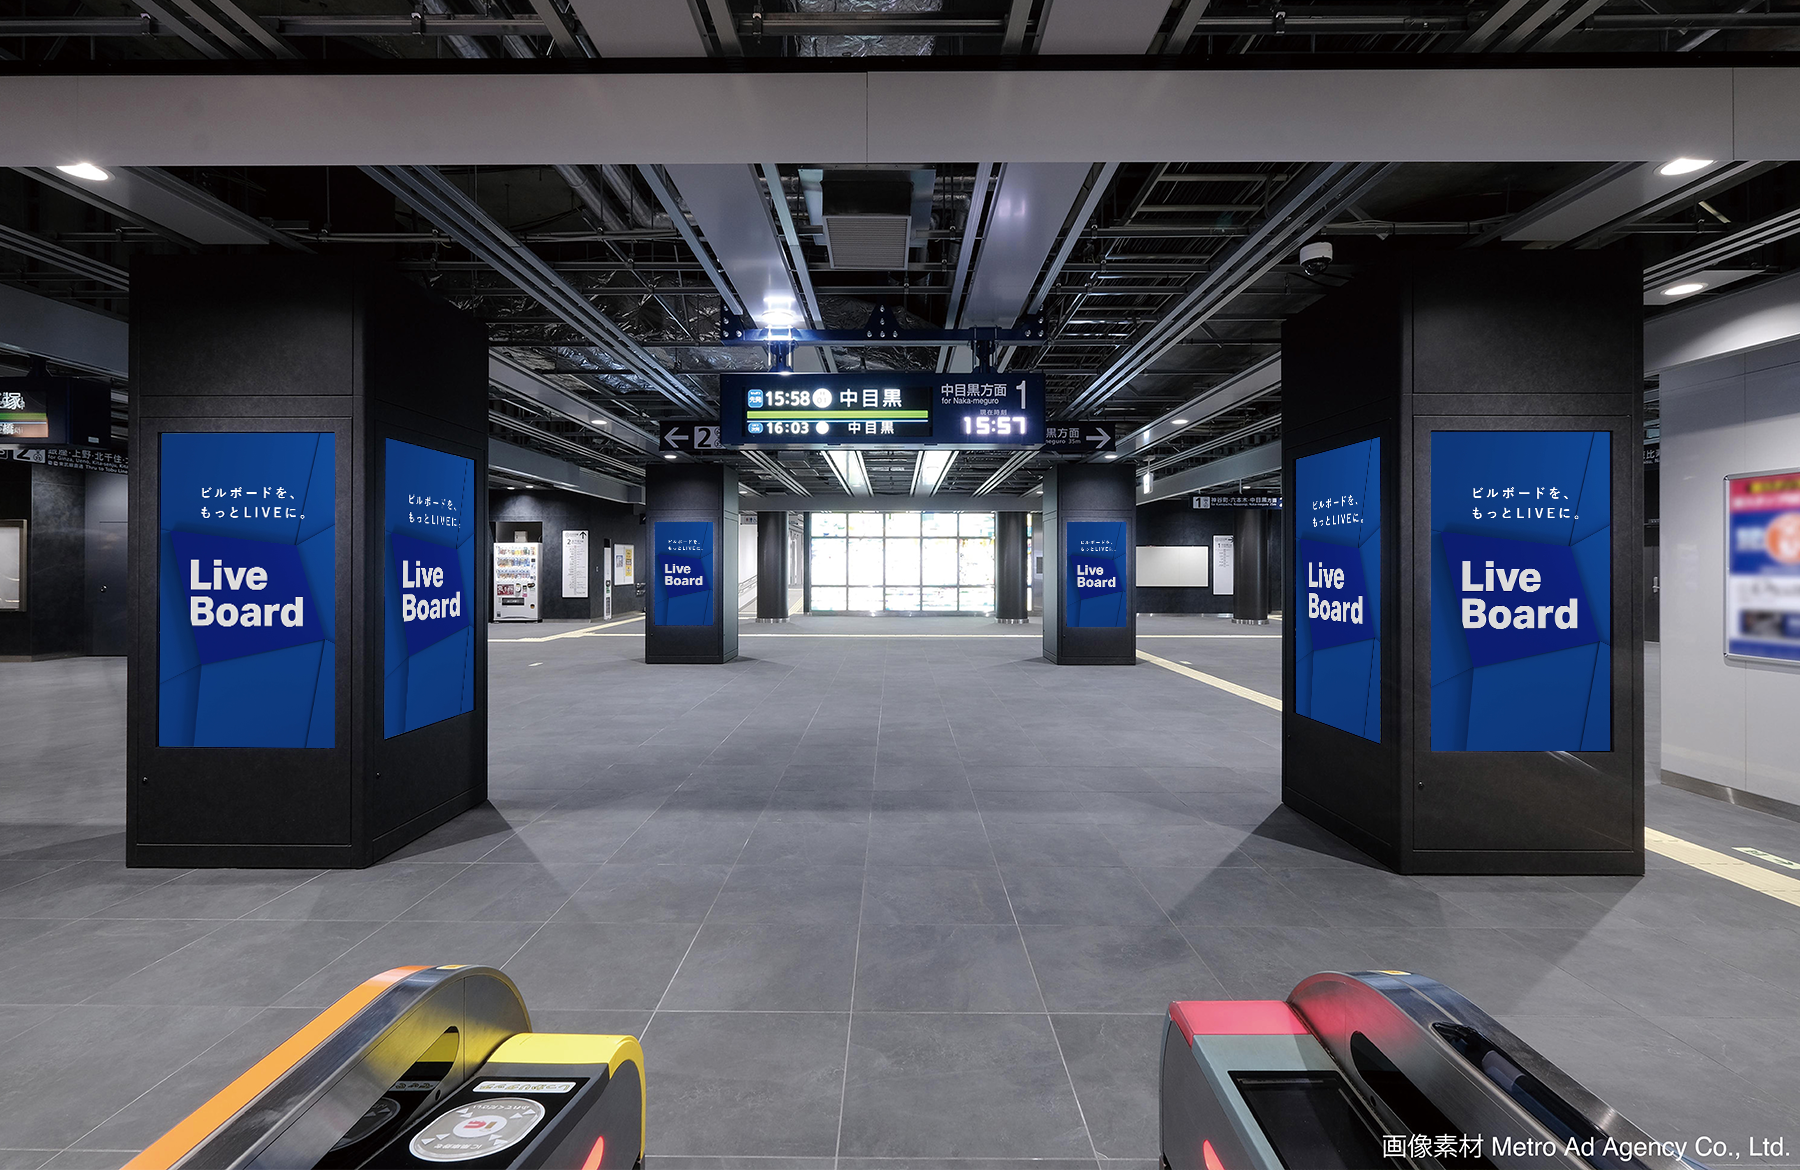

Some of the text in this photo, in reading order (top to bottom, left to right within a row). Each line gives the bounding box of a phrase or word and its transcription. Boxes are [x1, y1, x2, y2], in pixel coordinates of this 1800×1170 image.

[765, 390, 811, 407] 15:58
[839, 388, 902, 408] 中目黒
[941, 383, 1007, 397] 中目黒方面
[1016, 379, 1026, 410] 1
[941, 397, 1000, 406] for Naka-meguro
[766, 421, 810, 435] 16:03
[848, 421, 895, 435] 中目黒
[963, 415, 1027, 435] 15:57
[697, 427, 711, 447] 2
[201, 486, 296, 500] ビルボードを、
[1472, 486, 1570, 500] ビルボードを、
[1196, 497, 1201, 508] 1
[1312, 494, 1359, 511] ビルボードを、
[201, 506, 306, 520] もっとLIVEに。
[1312, 513, 1364, 528] もっとLIVEに。
[1472, 507, 1580, 520] もっとLIVEに。
[190, 558, 268, 591] Live
[402, 560, 444, 589] Live
[664, 563, 692, 574] Live
[1076, 564, 1104, 576] Live
[1308, 561, 1345, 589] Live
[1462, 560, 1542, 593] Live
[664, 575, 704, 586] Board
[1076, 576, 1116, 588] Board
[190, 596, 304, 628] Board
[402, 591, 461, 623] Board
[1308, 593, 1364, 625] Board
[1462, 597, 1578, 631] Board
